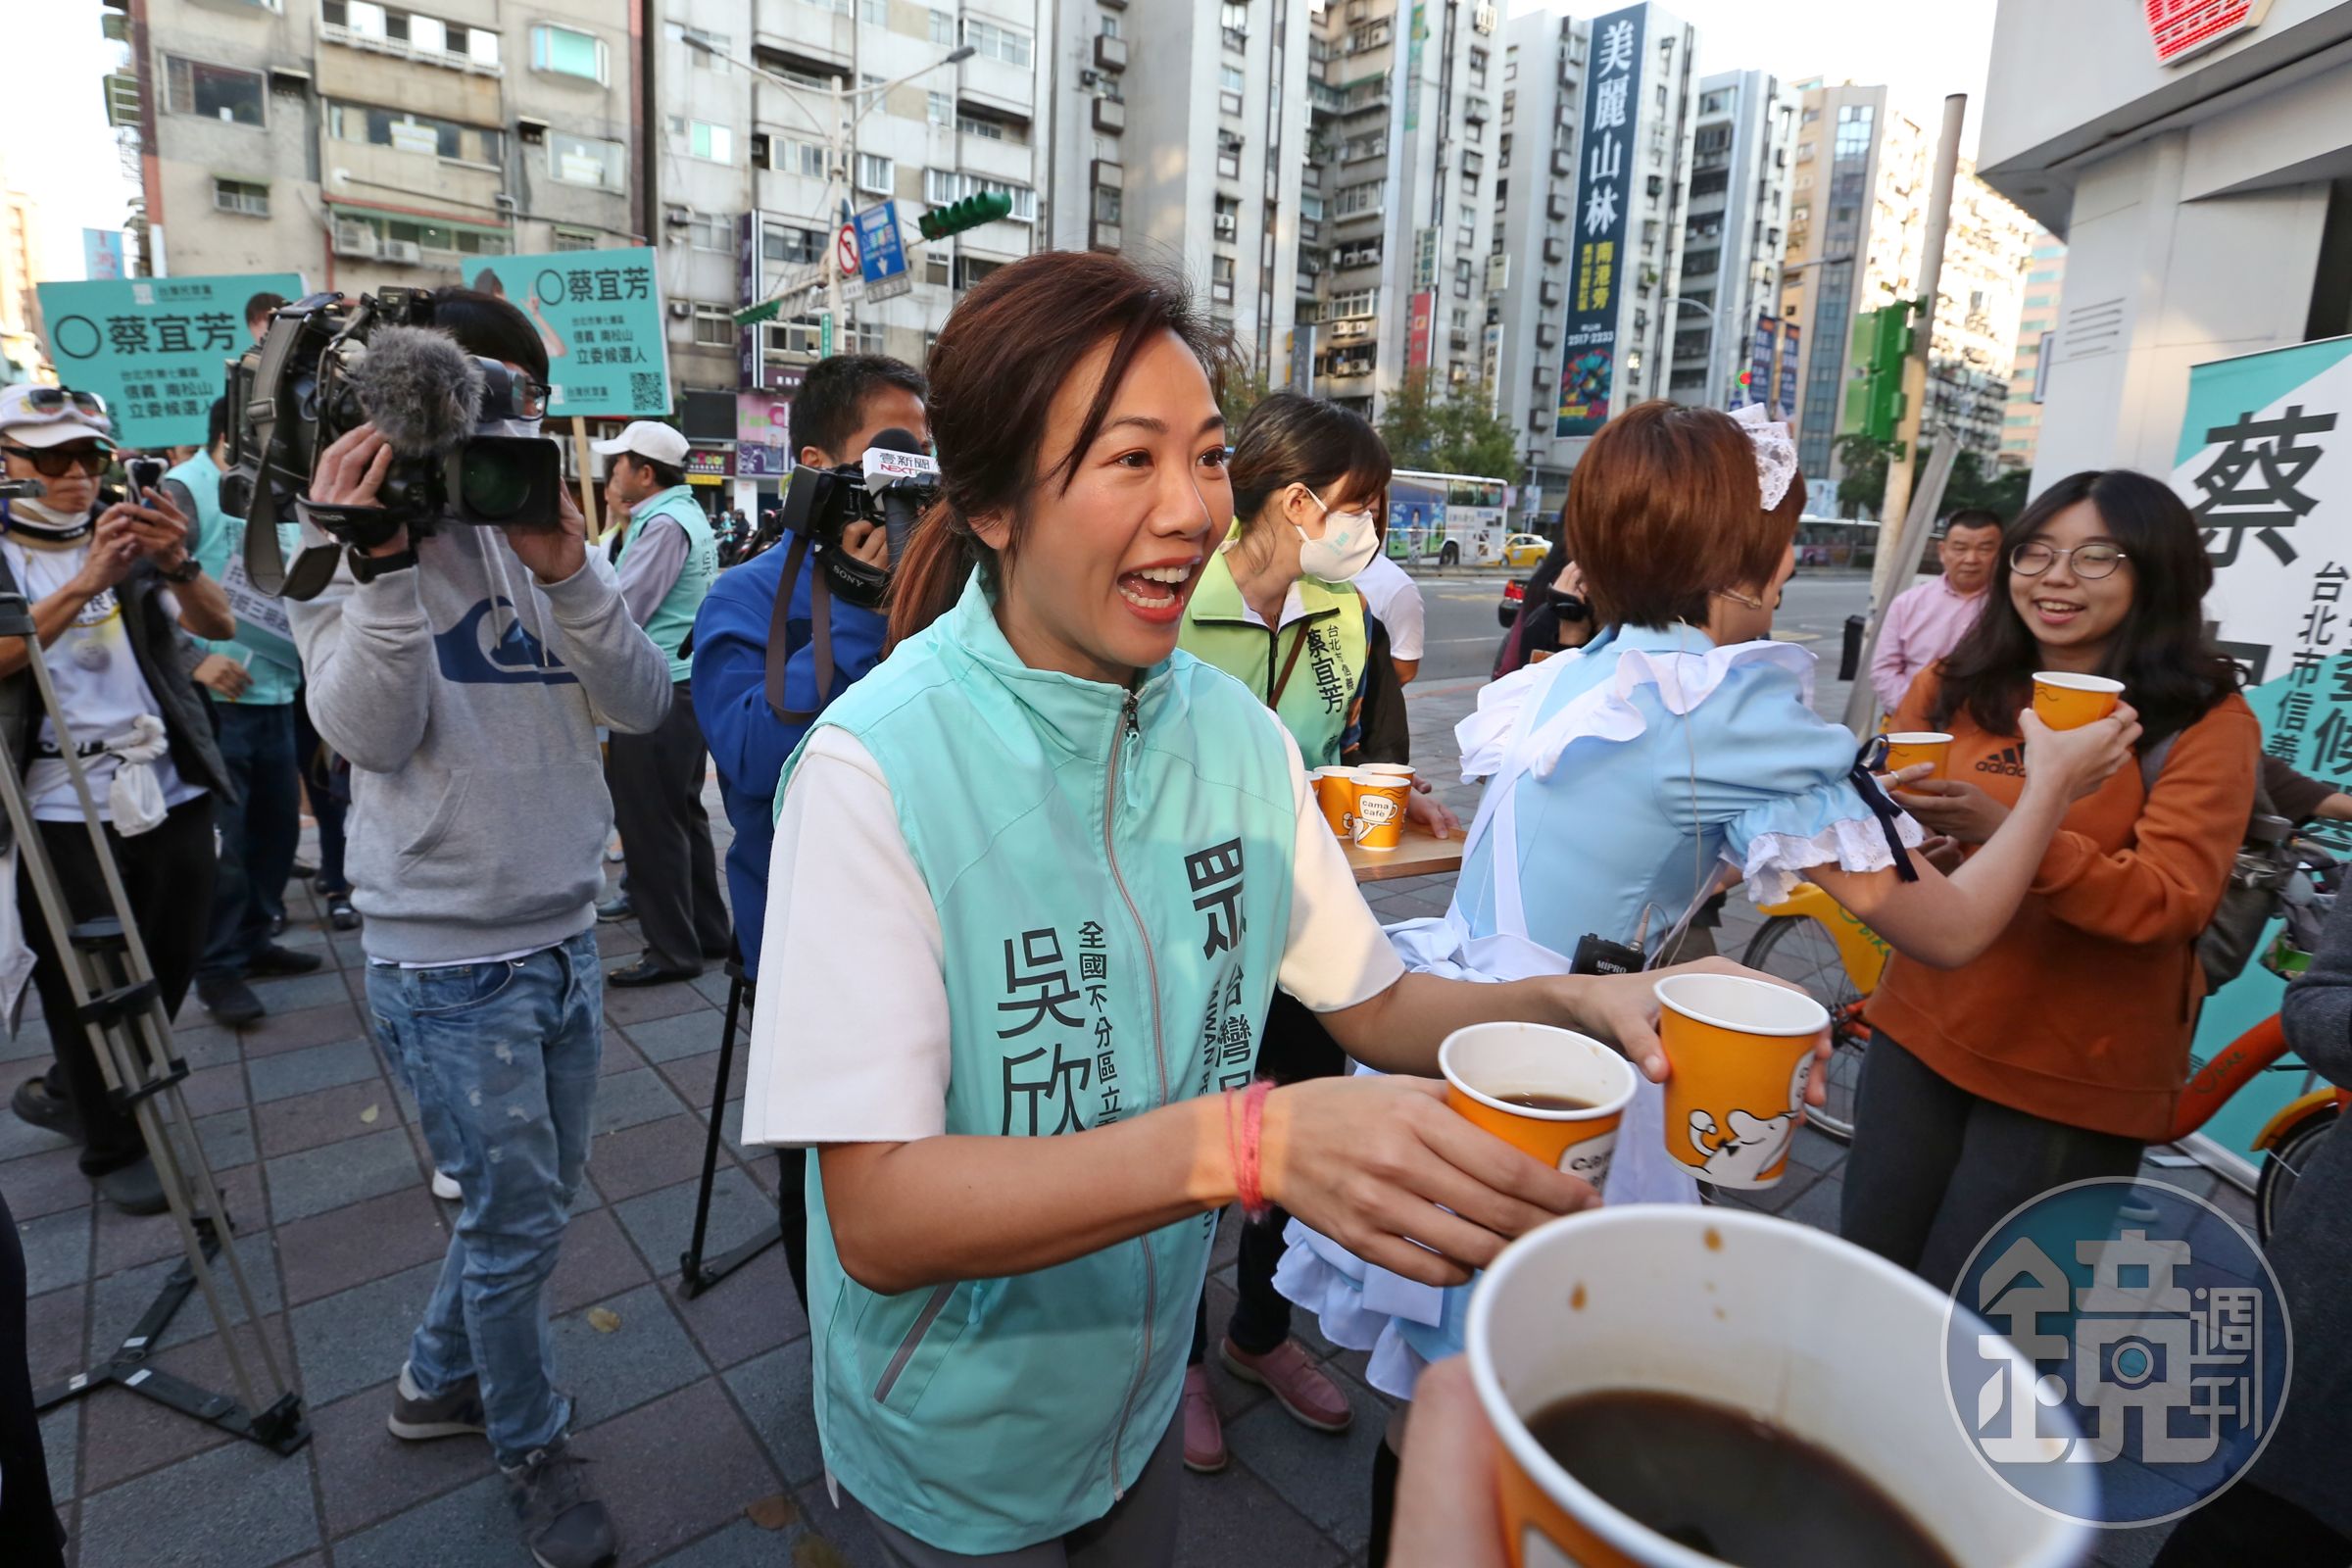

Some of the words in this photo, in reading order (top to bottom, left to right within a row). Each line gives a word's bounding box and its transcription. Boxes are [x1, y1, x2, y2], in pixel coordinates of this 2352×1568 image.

[1583, 20, 1635, 236] 美麗山林
[567, 266, 651, 303] 蔡宜芳
[1592, 242, 1614, 310] 南港旁
[106, 313, 236, 355] 蔡宜芳
[573, 330, 595, 344] 信義
[601, 328, 633, 343] 南松山
[576, 346, 648, 366] 立委候選人
[124, 384, 157, 400] 信義
[166, 382, 215, 397] 南松山
[129, 400, 214, 419] 立委候選人
[879, 453, 930, 469] 壹新聞
[834, 564, 864, 587] SONY
[1307, 629, 1345, 714] 蔡宜芳
[1362, 801, 1390, 809] cama
[1184, 837, 1247, 960] 眾
[1596, 960, 1627, 974] MIPRO
[997, 927, 1092, 1137] 吳欣
[1078, 921, 1122, 1128] 全國不分區立
